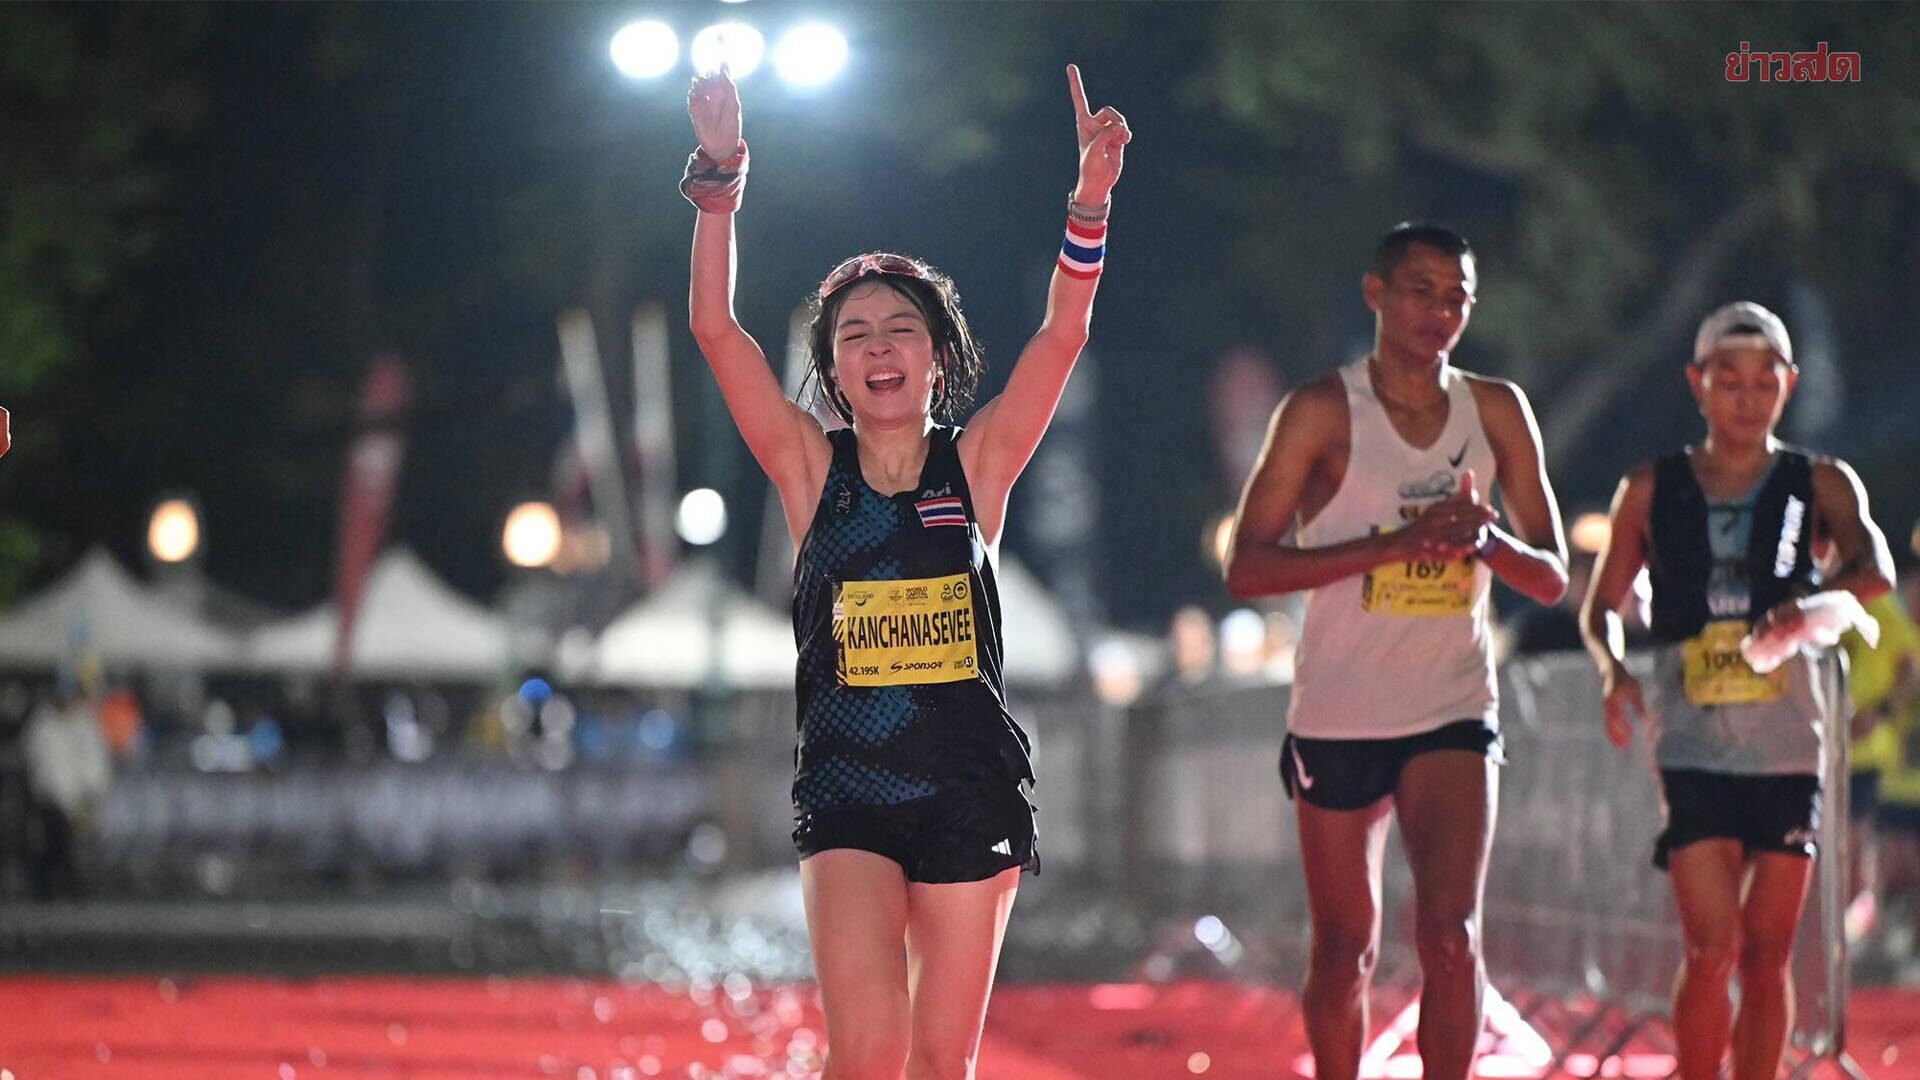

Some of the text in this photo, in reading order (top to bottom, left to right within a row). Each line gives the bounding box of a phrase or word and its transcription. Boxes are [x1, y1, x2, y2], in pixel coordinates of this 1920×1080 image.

[847, 607, 972, 650] KANCHANASEVEE
[848, 666, 880, 676] 42.195K
[903, 660, 944, 671] SPONSOR
